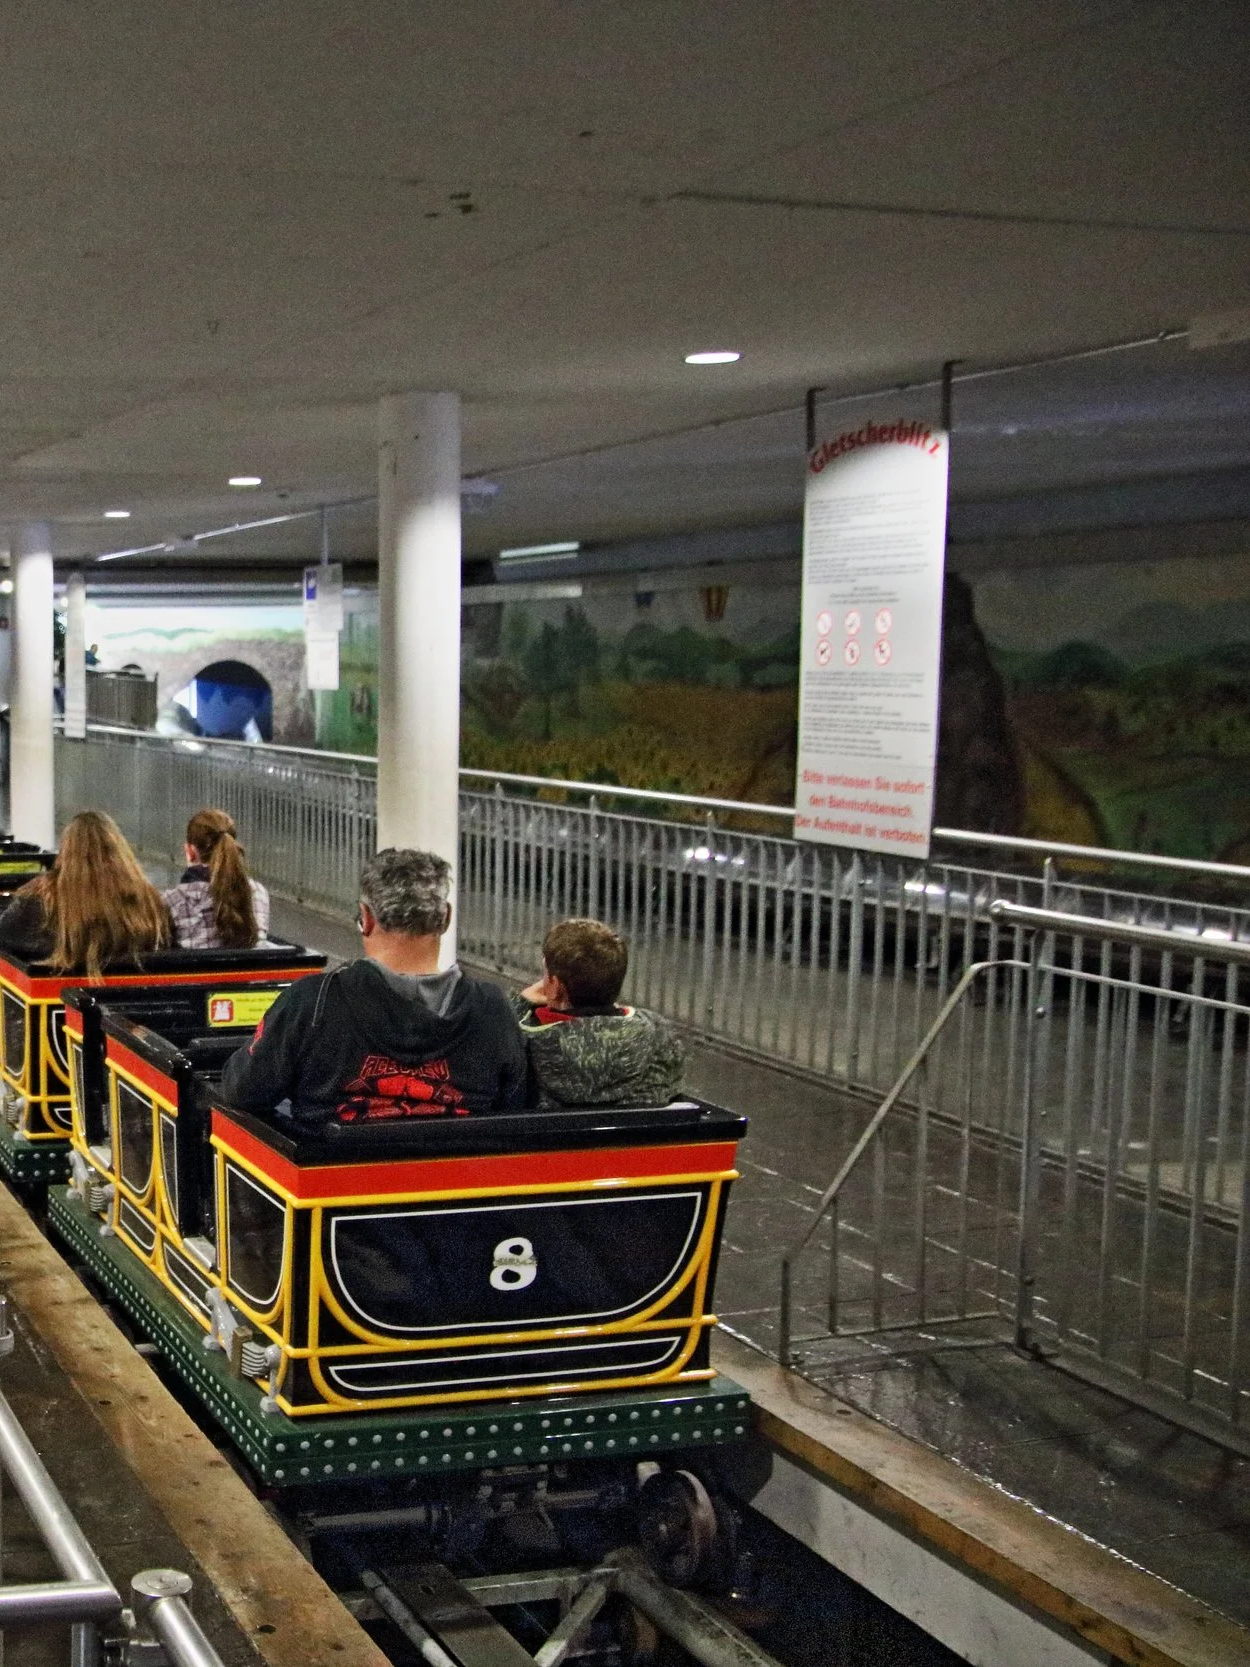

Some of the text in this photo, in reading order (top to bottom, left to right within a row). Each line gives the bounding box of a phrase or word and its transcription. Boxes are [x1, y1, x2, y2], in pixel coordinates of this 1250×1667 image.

[803, 769, 925, 794] Bitte verlassen Sie sofort
[795, 814, 810, 828] Der
[814, 816, 862, 836] Aufenthalt
[490, 1237, 537, 1290] 8
